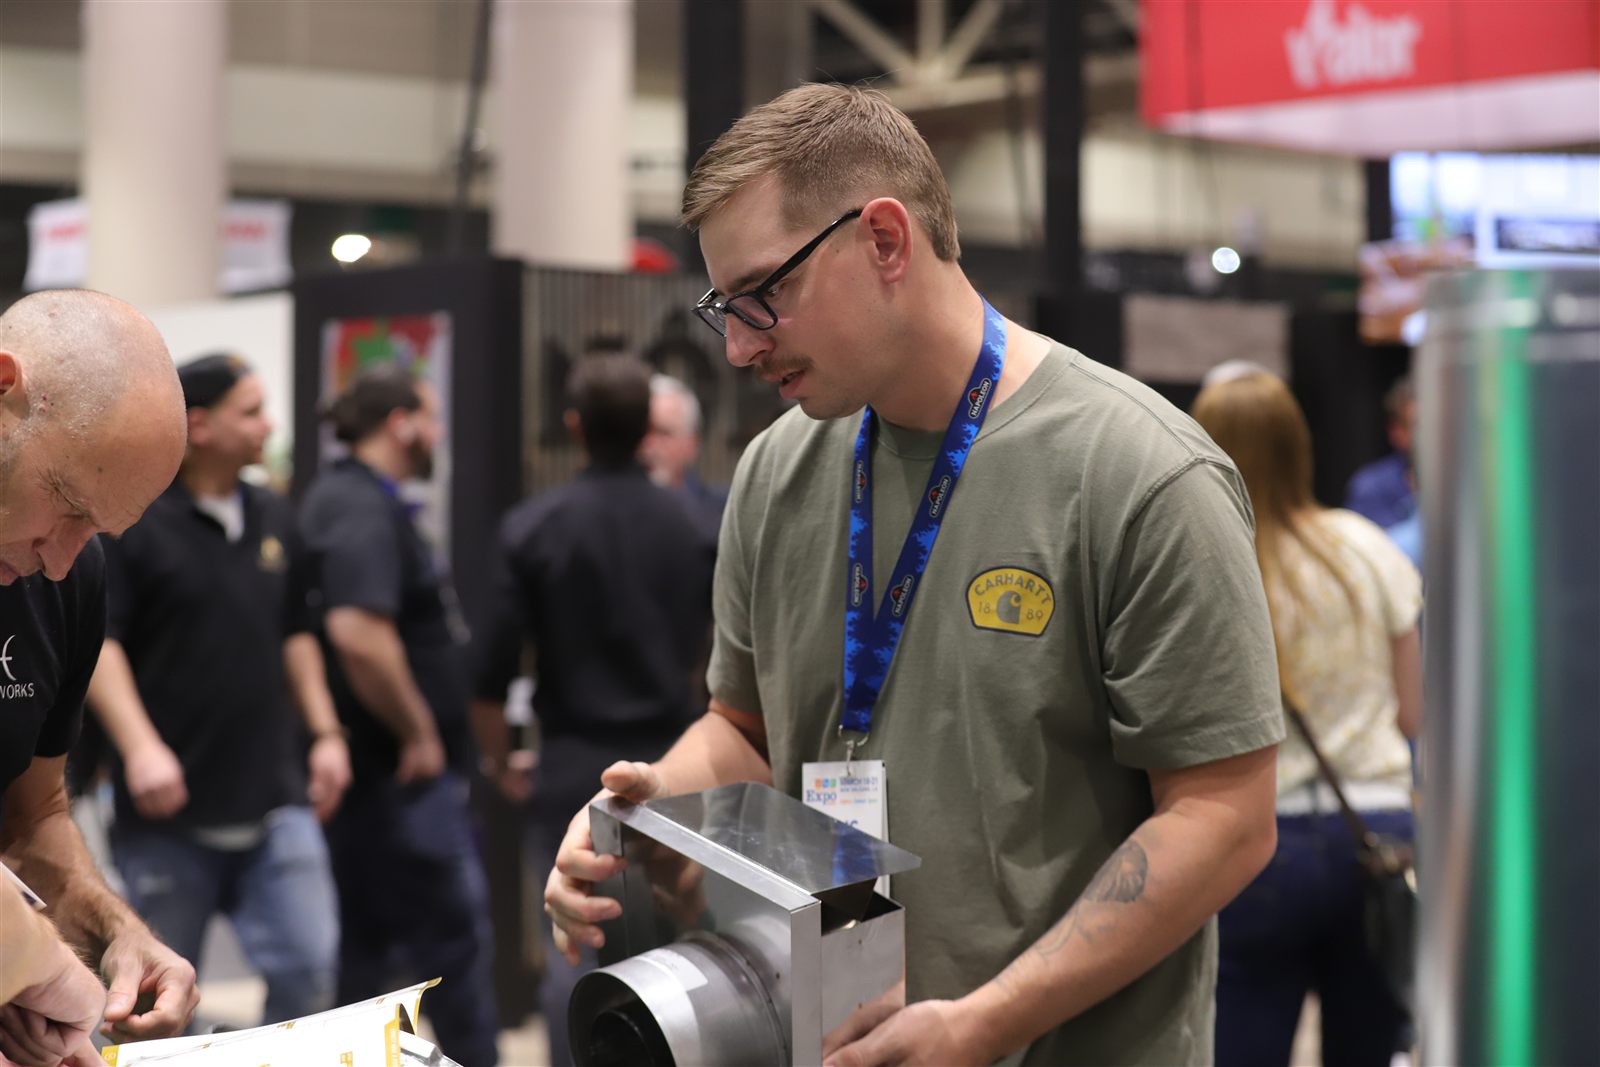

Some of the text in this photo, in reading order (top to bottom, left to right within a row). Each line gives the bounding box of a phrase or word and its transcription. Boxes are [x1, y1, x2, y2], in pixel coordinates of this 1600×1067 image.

[971, 380, 990, 417] NAPOLEON
[932, 479, 949, 515] NAPOLEON
[894, 577, 912, 614] NAPOLEON
[974, 574, 1052, 604] CARHARTT
[978, 602, 991, 615] 18
[806, 789, 837, 805] Expo
